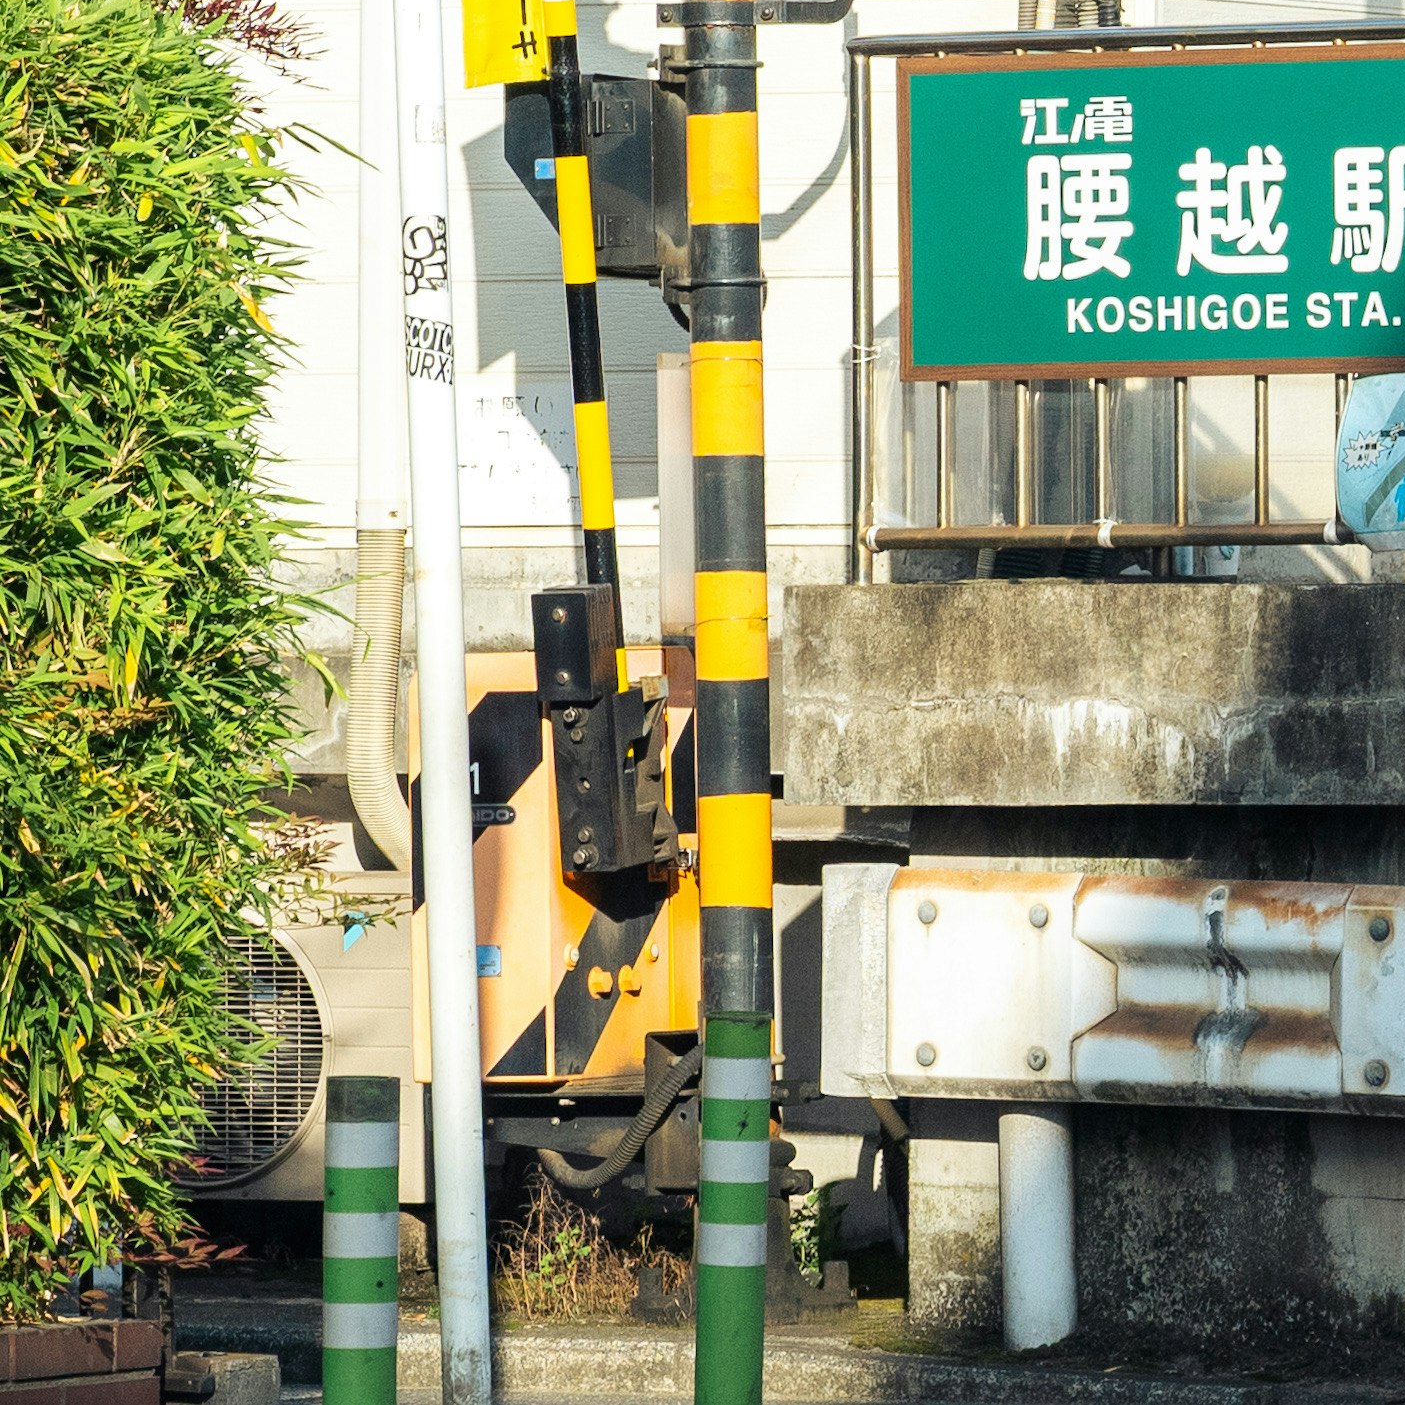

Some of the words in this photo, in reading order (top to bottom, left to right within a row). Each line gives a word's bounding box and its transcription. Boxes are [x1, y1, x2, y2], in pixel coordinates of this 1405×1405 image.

[1020, 95, 1133, 145] 江ノ電
[1066, 293, 1390, 334] KOSHIGOE
[1305, 291, 1402, 329] STA.
